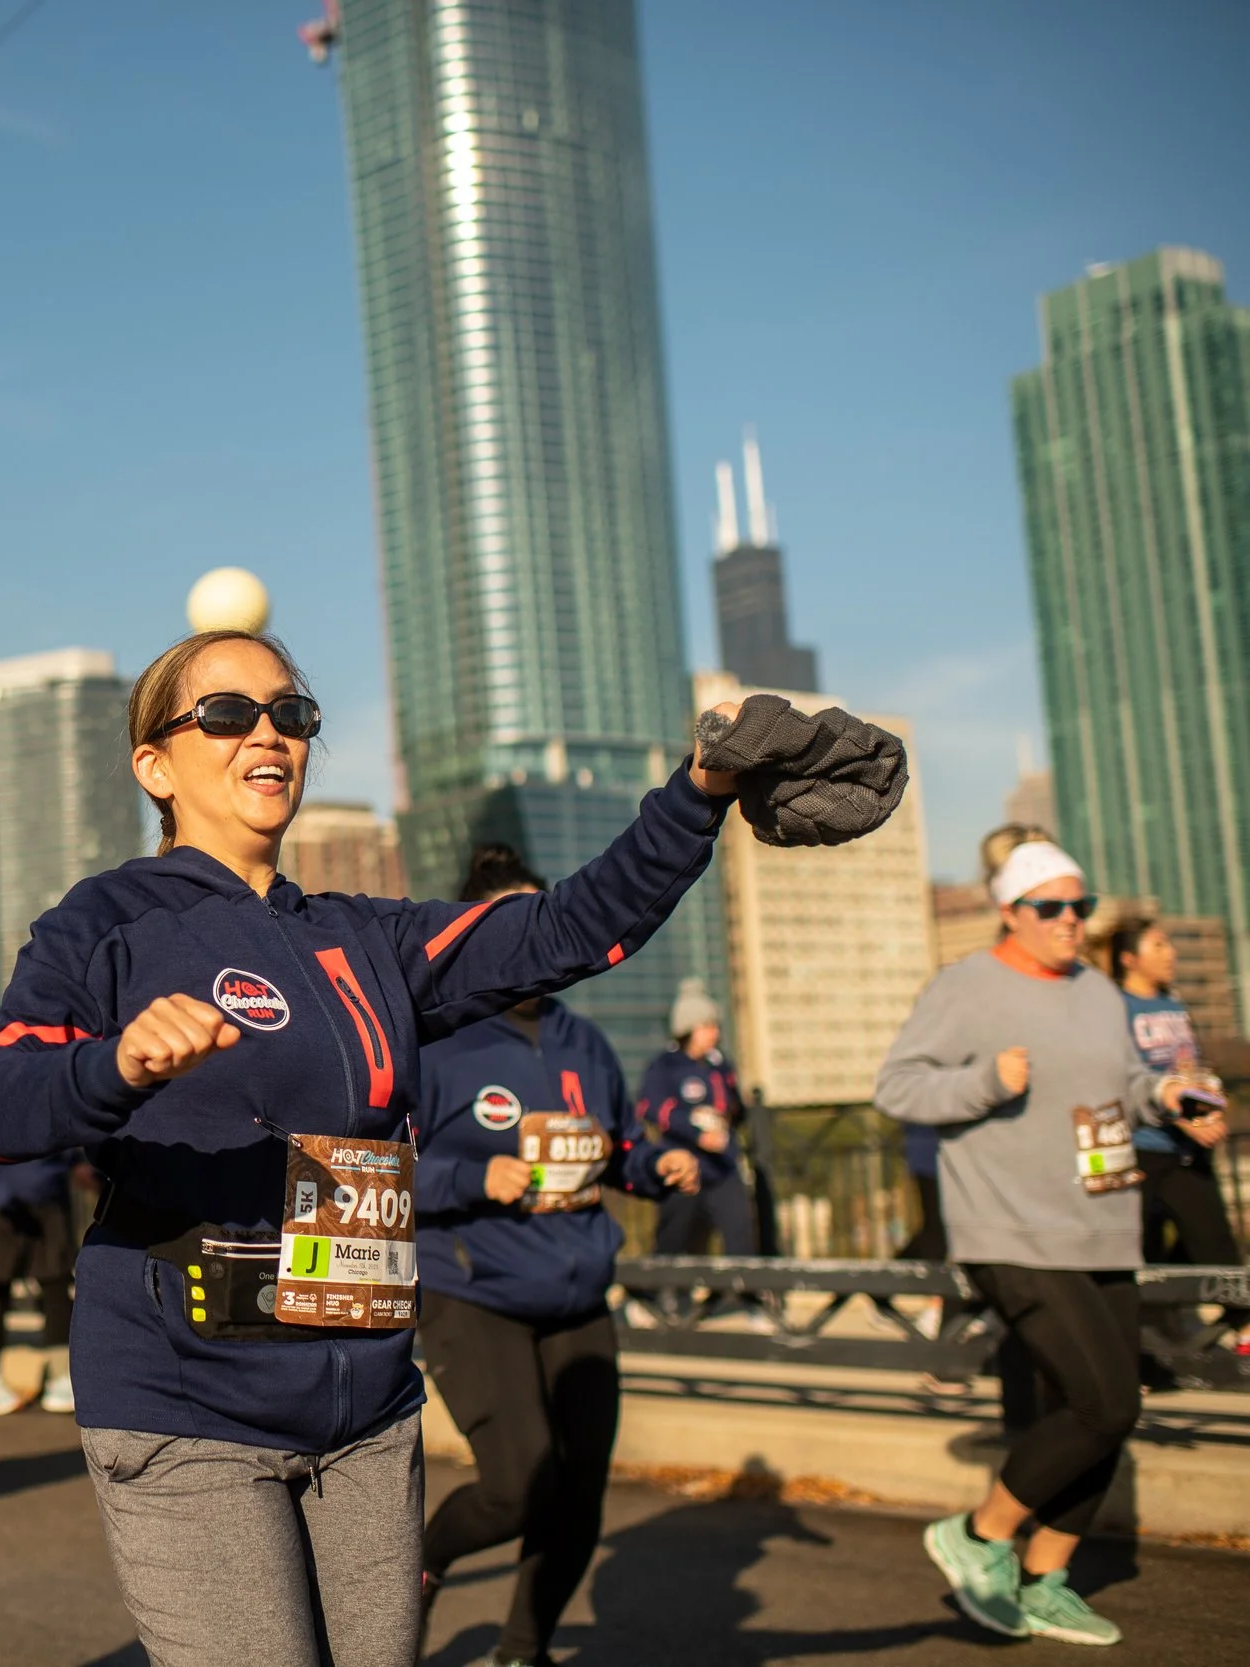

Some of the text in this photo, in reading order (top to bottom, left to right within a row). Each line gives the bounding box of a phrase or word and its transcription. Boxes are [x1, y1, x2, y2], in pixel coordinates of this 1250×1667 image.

[224, 980, 268, 998] HOT
[246, 1008, 275, 1019] RUN
[330, 1147, 365, 1165] HOT
[361, 1166, 375, 1174] RUN
[300, 1190, 314, 1213] 5K
[333, 1184, 412, 1229] 9409
[306, 1242, 319, 1274] J
[334, 1243, 381, 1261] Marie
[258, 1272, 275, 1280] One
[326, 1293, 354, 1301] FINISHER
[372, 1299, 412, 1310] GEAR CHECK
